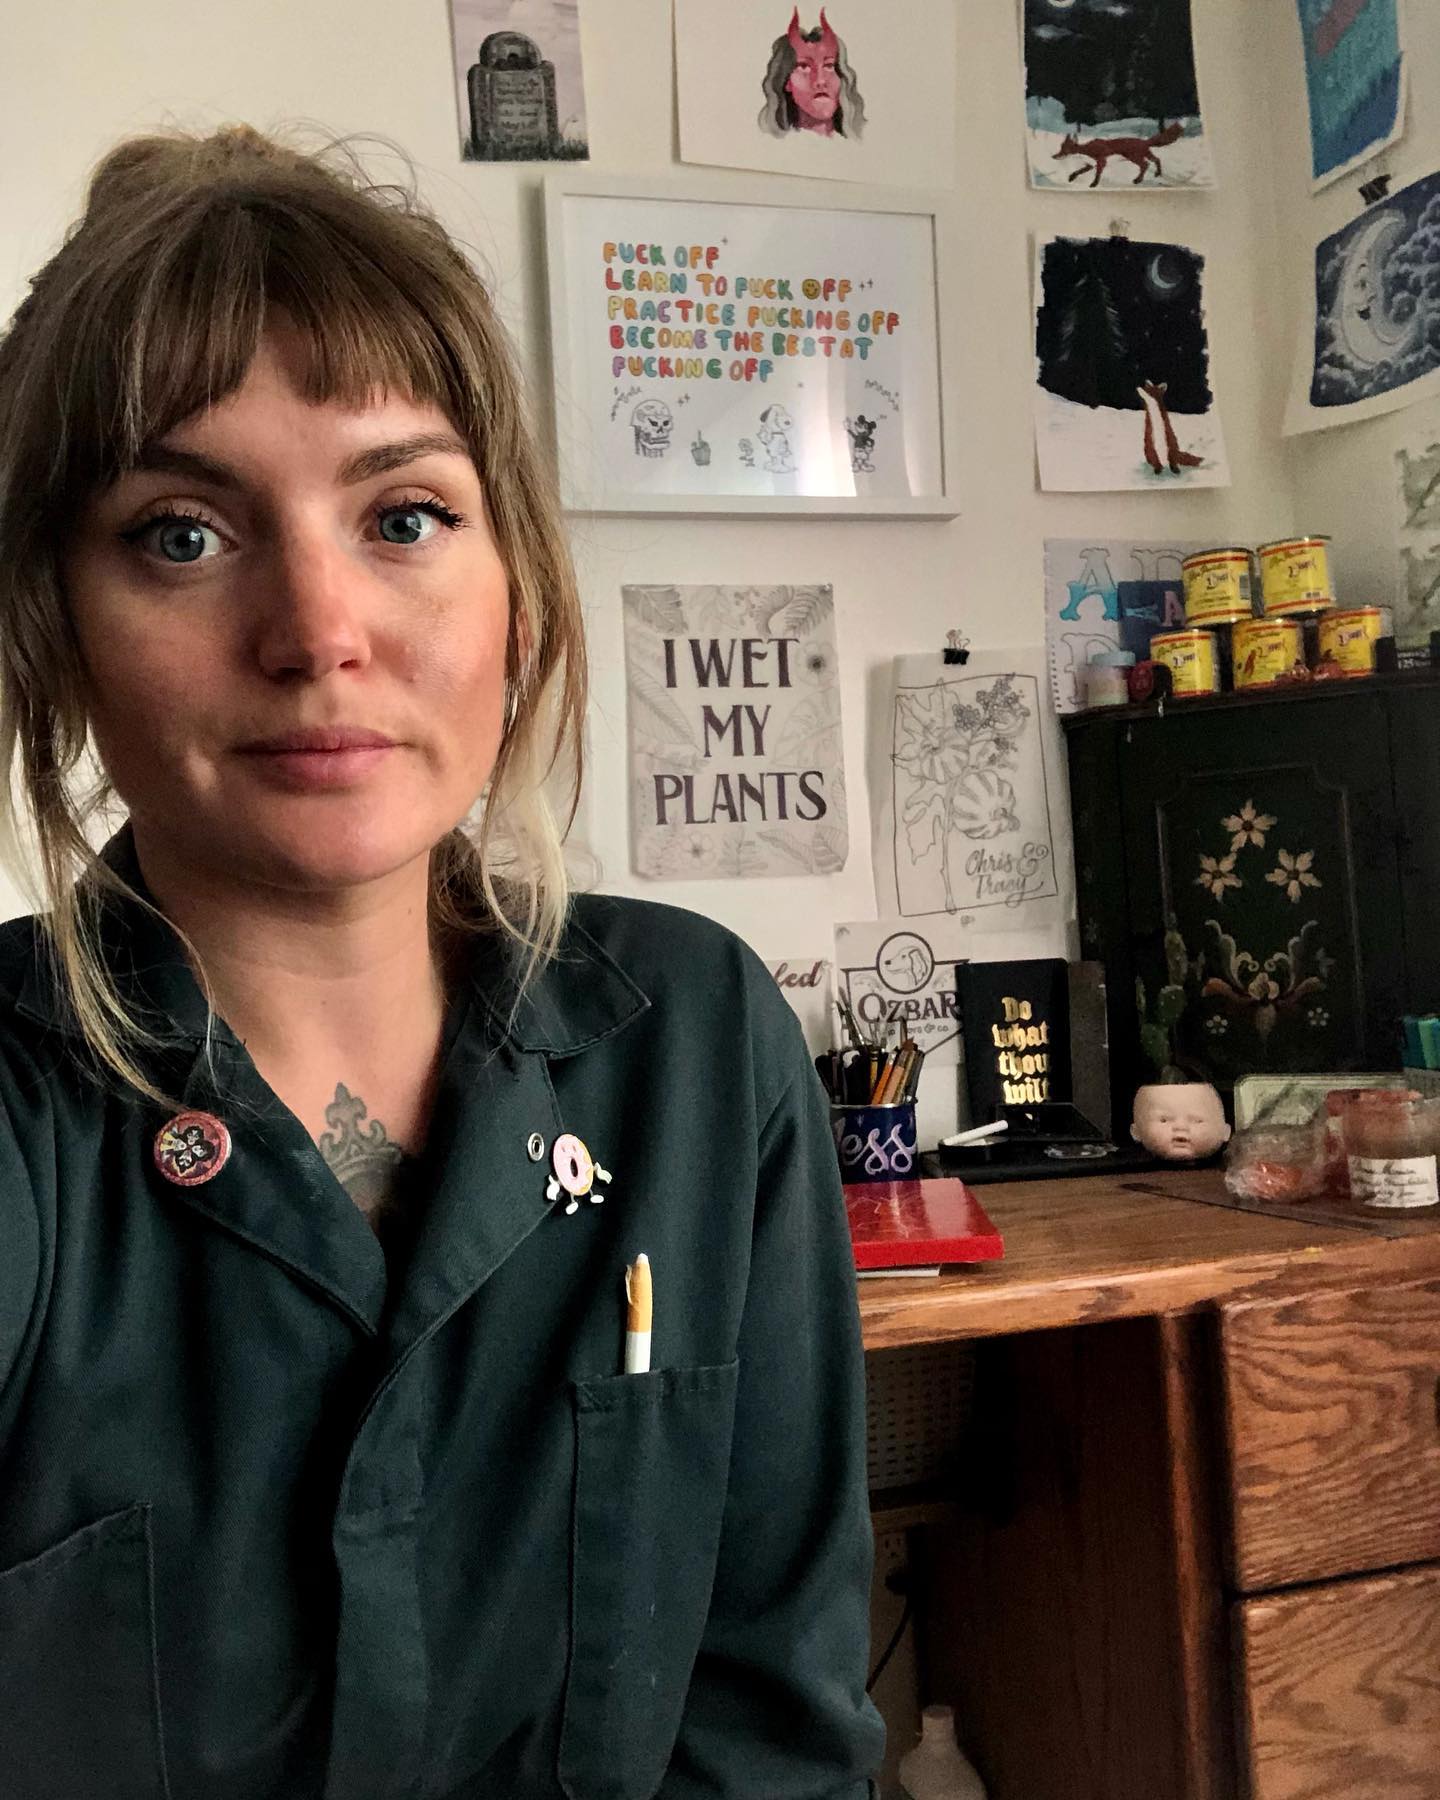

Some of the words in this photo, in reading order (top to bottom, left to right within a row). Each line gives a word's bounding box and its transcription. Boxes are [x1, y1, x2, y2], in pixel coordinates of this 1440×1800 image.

[602, 242, 666, 266] FUCK
[674, 246, 720, 270] OFF
[605, 267, 687, 294] LEARN
[696, 273, 728, 297] TO
[735, 277, 794, 300] FUCK
[607, 296, 736, 326] PRACTICE
[747, 305, 851, 331] FUCKING
[857, 310, 900, 336] OFF
[610, 325, 708, 350] BECOME
[715, 329, 764, 353] THE
[772, 332, 836, 357] BEST
[839, 337, 873, 360] AT
[612, 356, 722, 380] FUCKING
[729, 357, 774, 383] OFF
[663, 639, 678, 689] I
[688, 638, 800, 688] WET
[701, 704, 772, 758] MY
[652, 770, 827, 826] PLANTS
[965, 848, 1013, 876] Chris
[975, 873, 1044, 908] Tracy
[1002, 997, 1032, 1021] Do
[991, 1021, 1049, 1051] what
[999, 1051, 1048, 1080] thou
